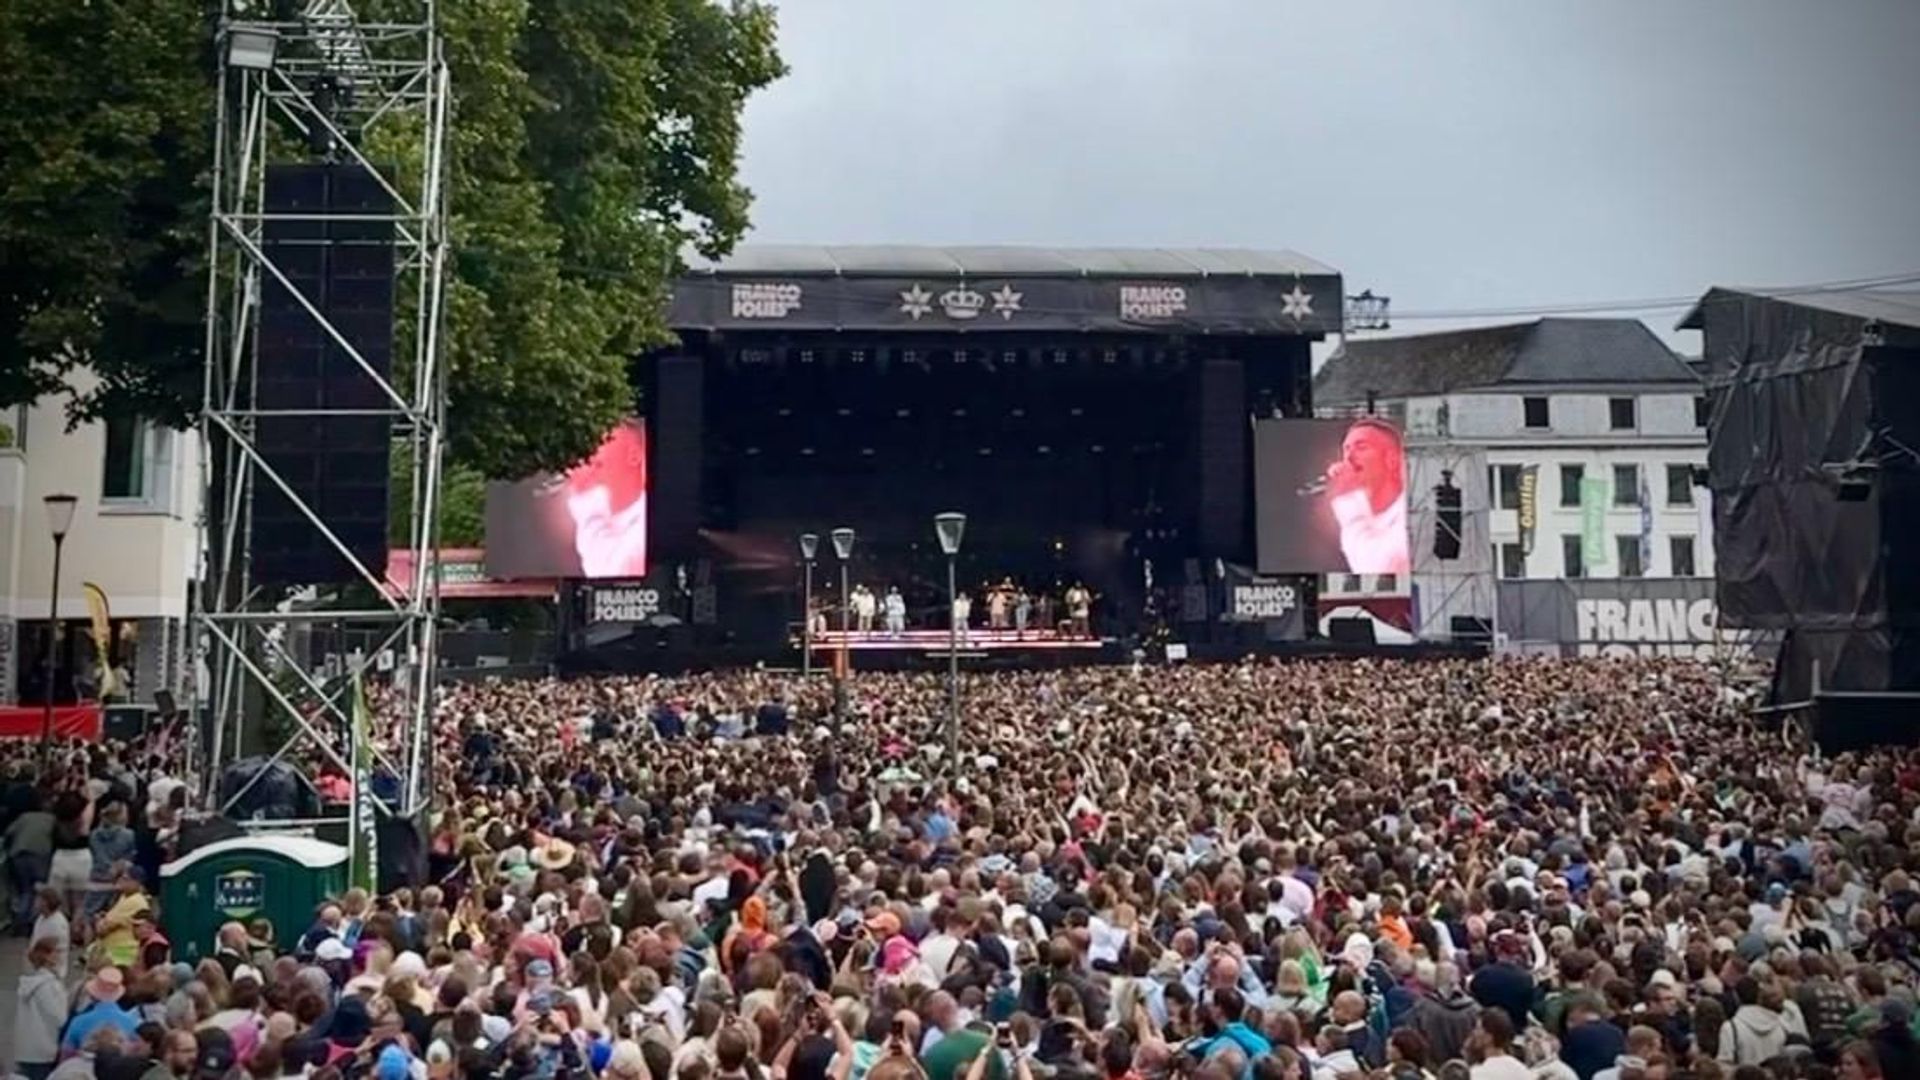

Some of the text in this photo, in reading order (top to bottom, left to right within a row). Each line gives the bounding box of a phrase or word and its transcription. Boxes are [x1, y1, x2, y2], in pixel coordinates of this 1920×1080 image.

[732, 284, 801, 301] FRANCO
[1121, 286, 1186, 303] FRANCO
[595, 589, 659, 606] FRANCO
[1235, 586, 1294, 603] FRANCO
[1577, 598, 1748, 642] FRANC
